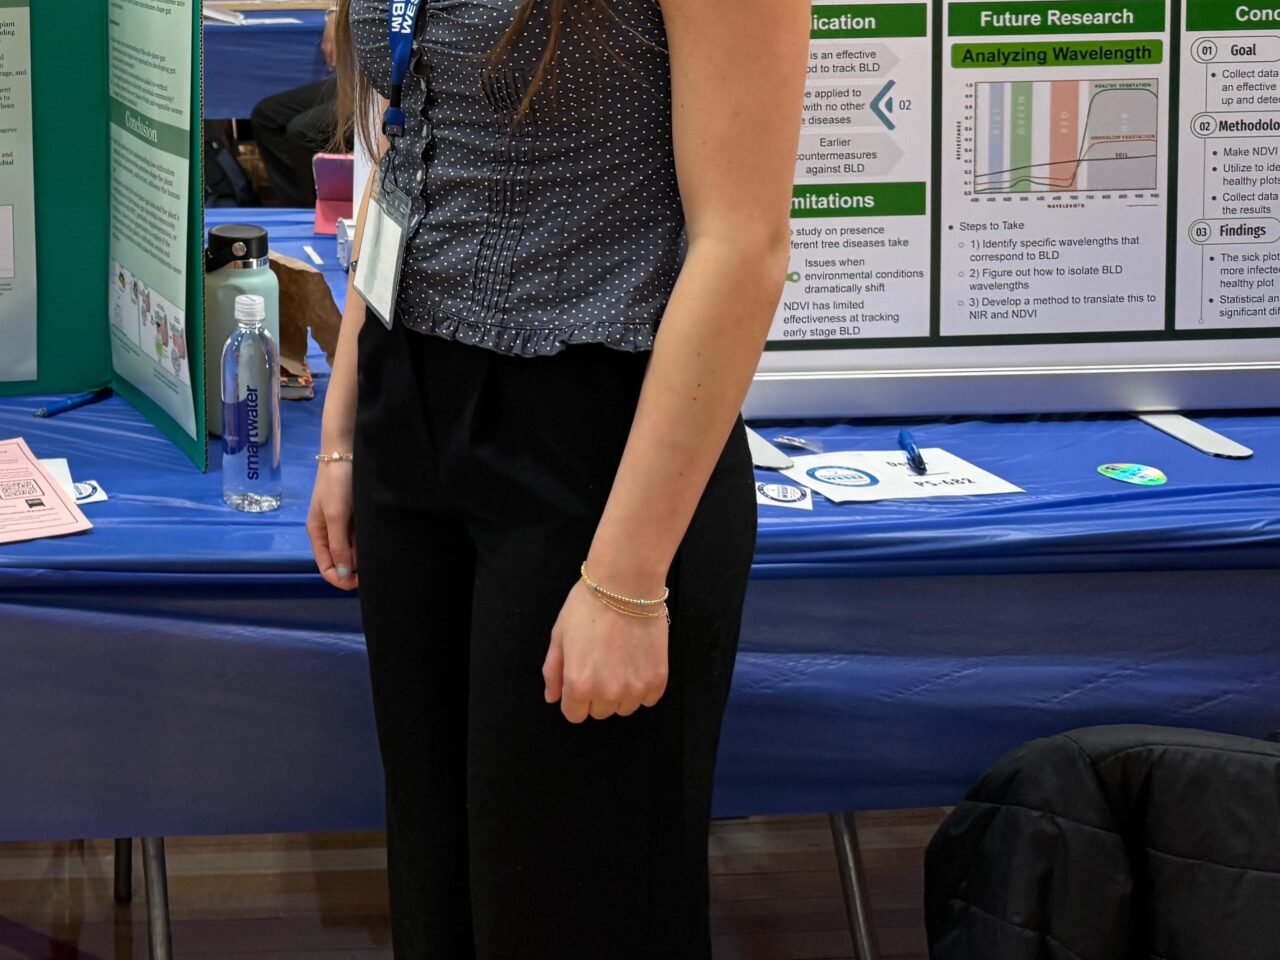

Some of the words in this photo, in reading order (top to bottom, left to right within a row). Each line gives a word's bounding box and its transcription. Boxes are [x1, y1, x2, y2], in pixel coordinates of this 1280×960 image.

[813, 14, 876, 30] ication
[980, 11, 1041, 26] Future
[1047, 8, 1133, 24] Research
[961, 48, 1046, 65] Analyzing
[1052, 42, 1151, 62] Wavelength
[126, 110, 157, 142] Conclusion
[791, 192, 875, 210] mitations
[1220, 223, 1265, 238] Findings
[247, 385, 258, 480] smartwater
[913, 478, 976, 488] PS-682
